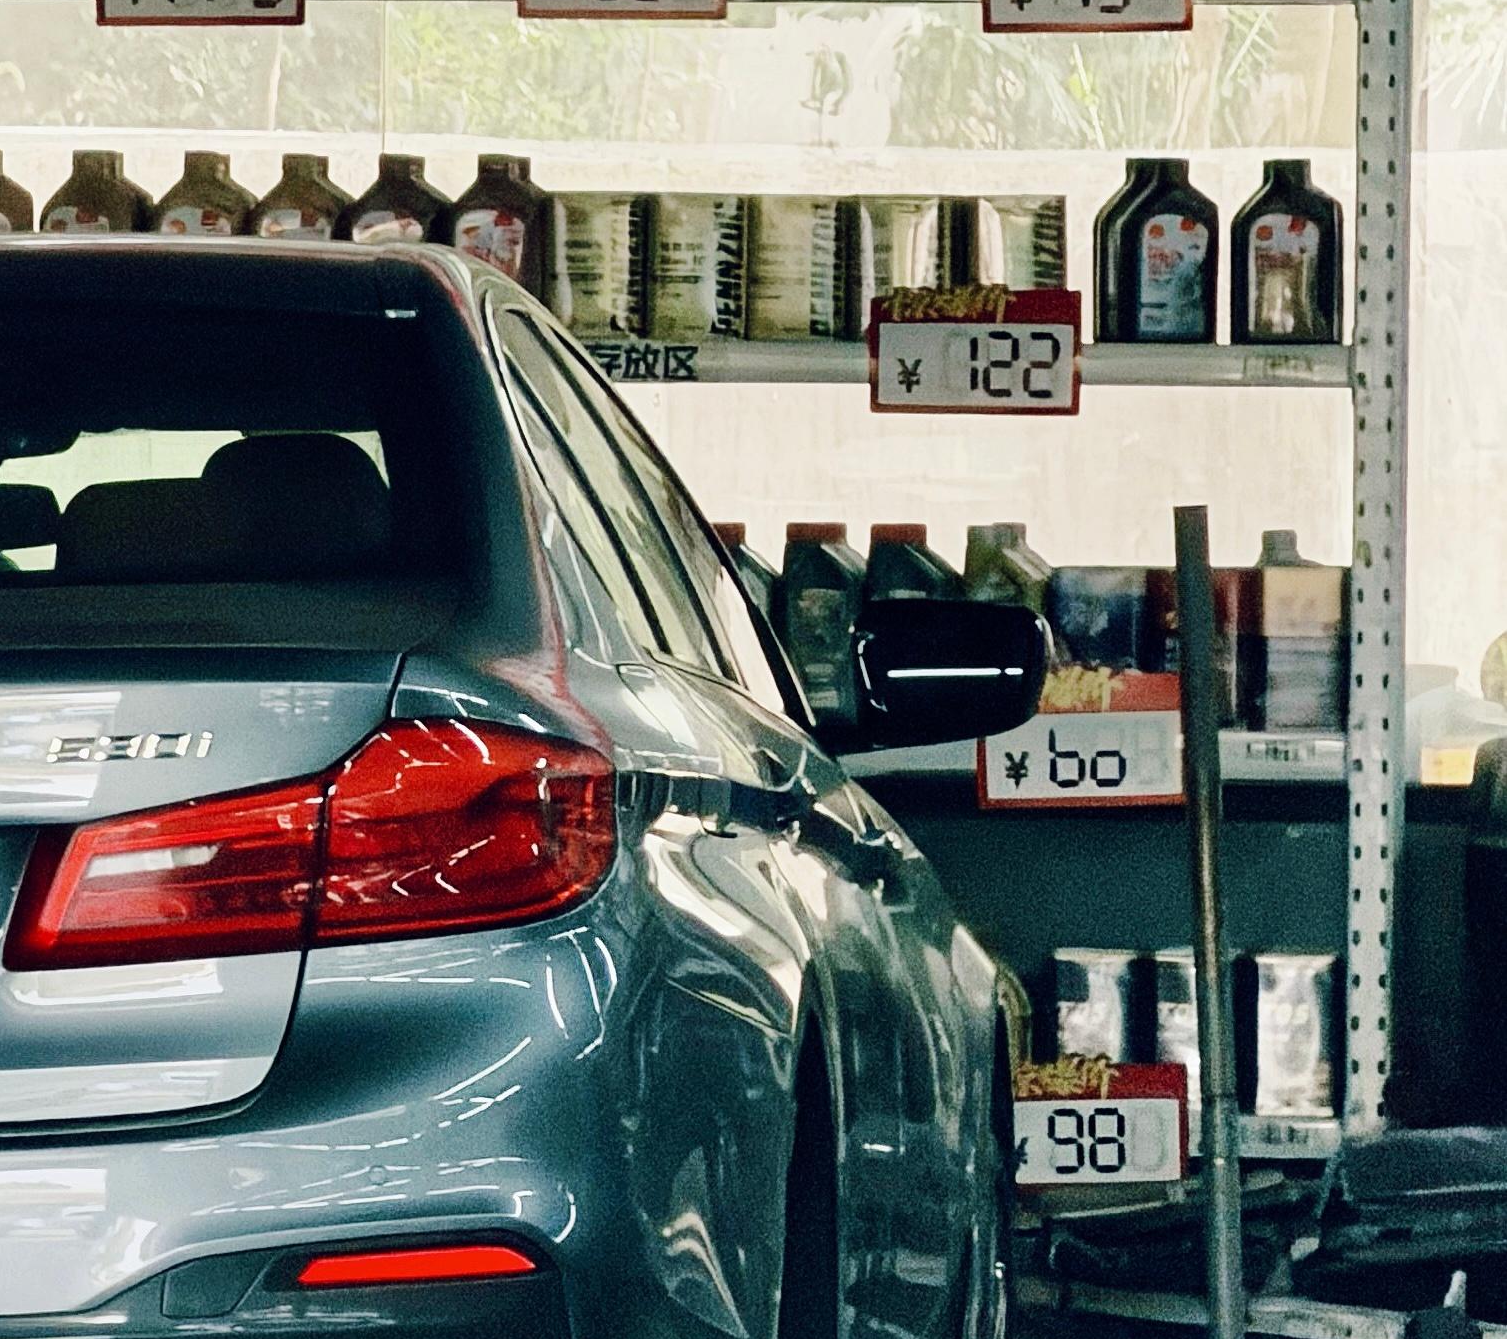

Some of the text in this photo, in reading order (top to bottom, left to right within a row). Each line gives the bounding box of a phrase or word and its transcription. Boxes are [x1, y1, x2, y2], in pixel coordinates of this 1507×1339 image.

[969, 330, 1061, 398] 122
[46, 731, 213, 763] 530i
[1047, 1107, 1126, 1174] 98
